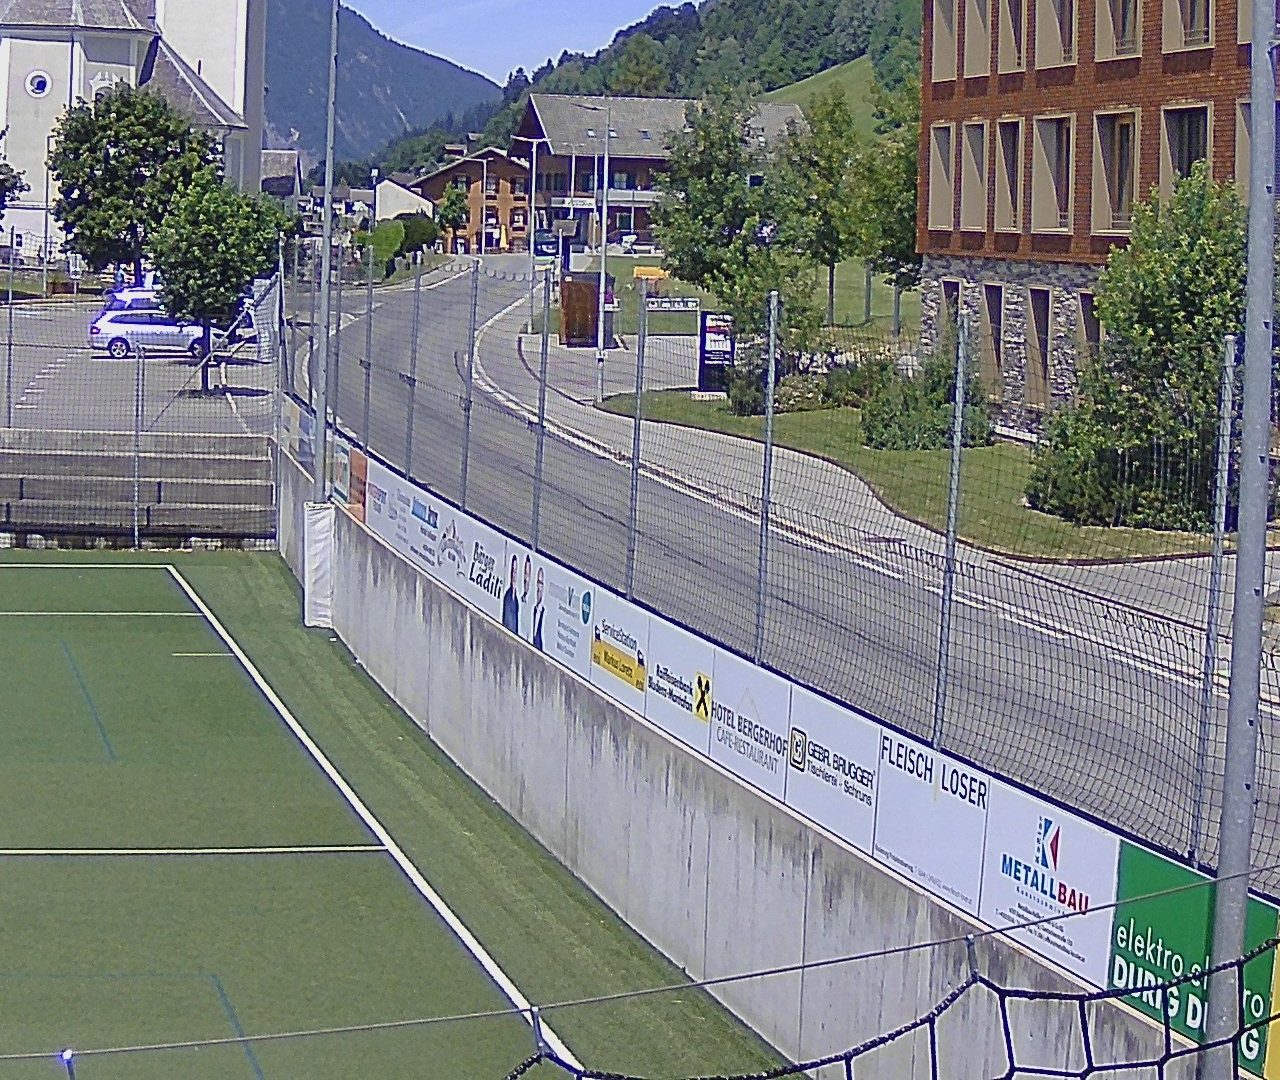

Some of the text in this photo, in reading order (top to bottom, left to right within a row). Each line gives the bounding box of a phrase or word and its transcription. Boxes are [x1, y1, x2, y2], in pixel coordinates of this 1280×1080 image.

[711, 700, 789, 757] HOTEL BERGERHOF
[807, 740, 874, 790] GEBR. BRUGGER
[881, 735, 987, 810] FLEISCH LOSER
[1001, 853, 1089, 915] METALLBAU
[1116, 917, 1184, 977] elektro
